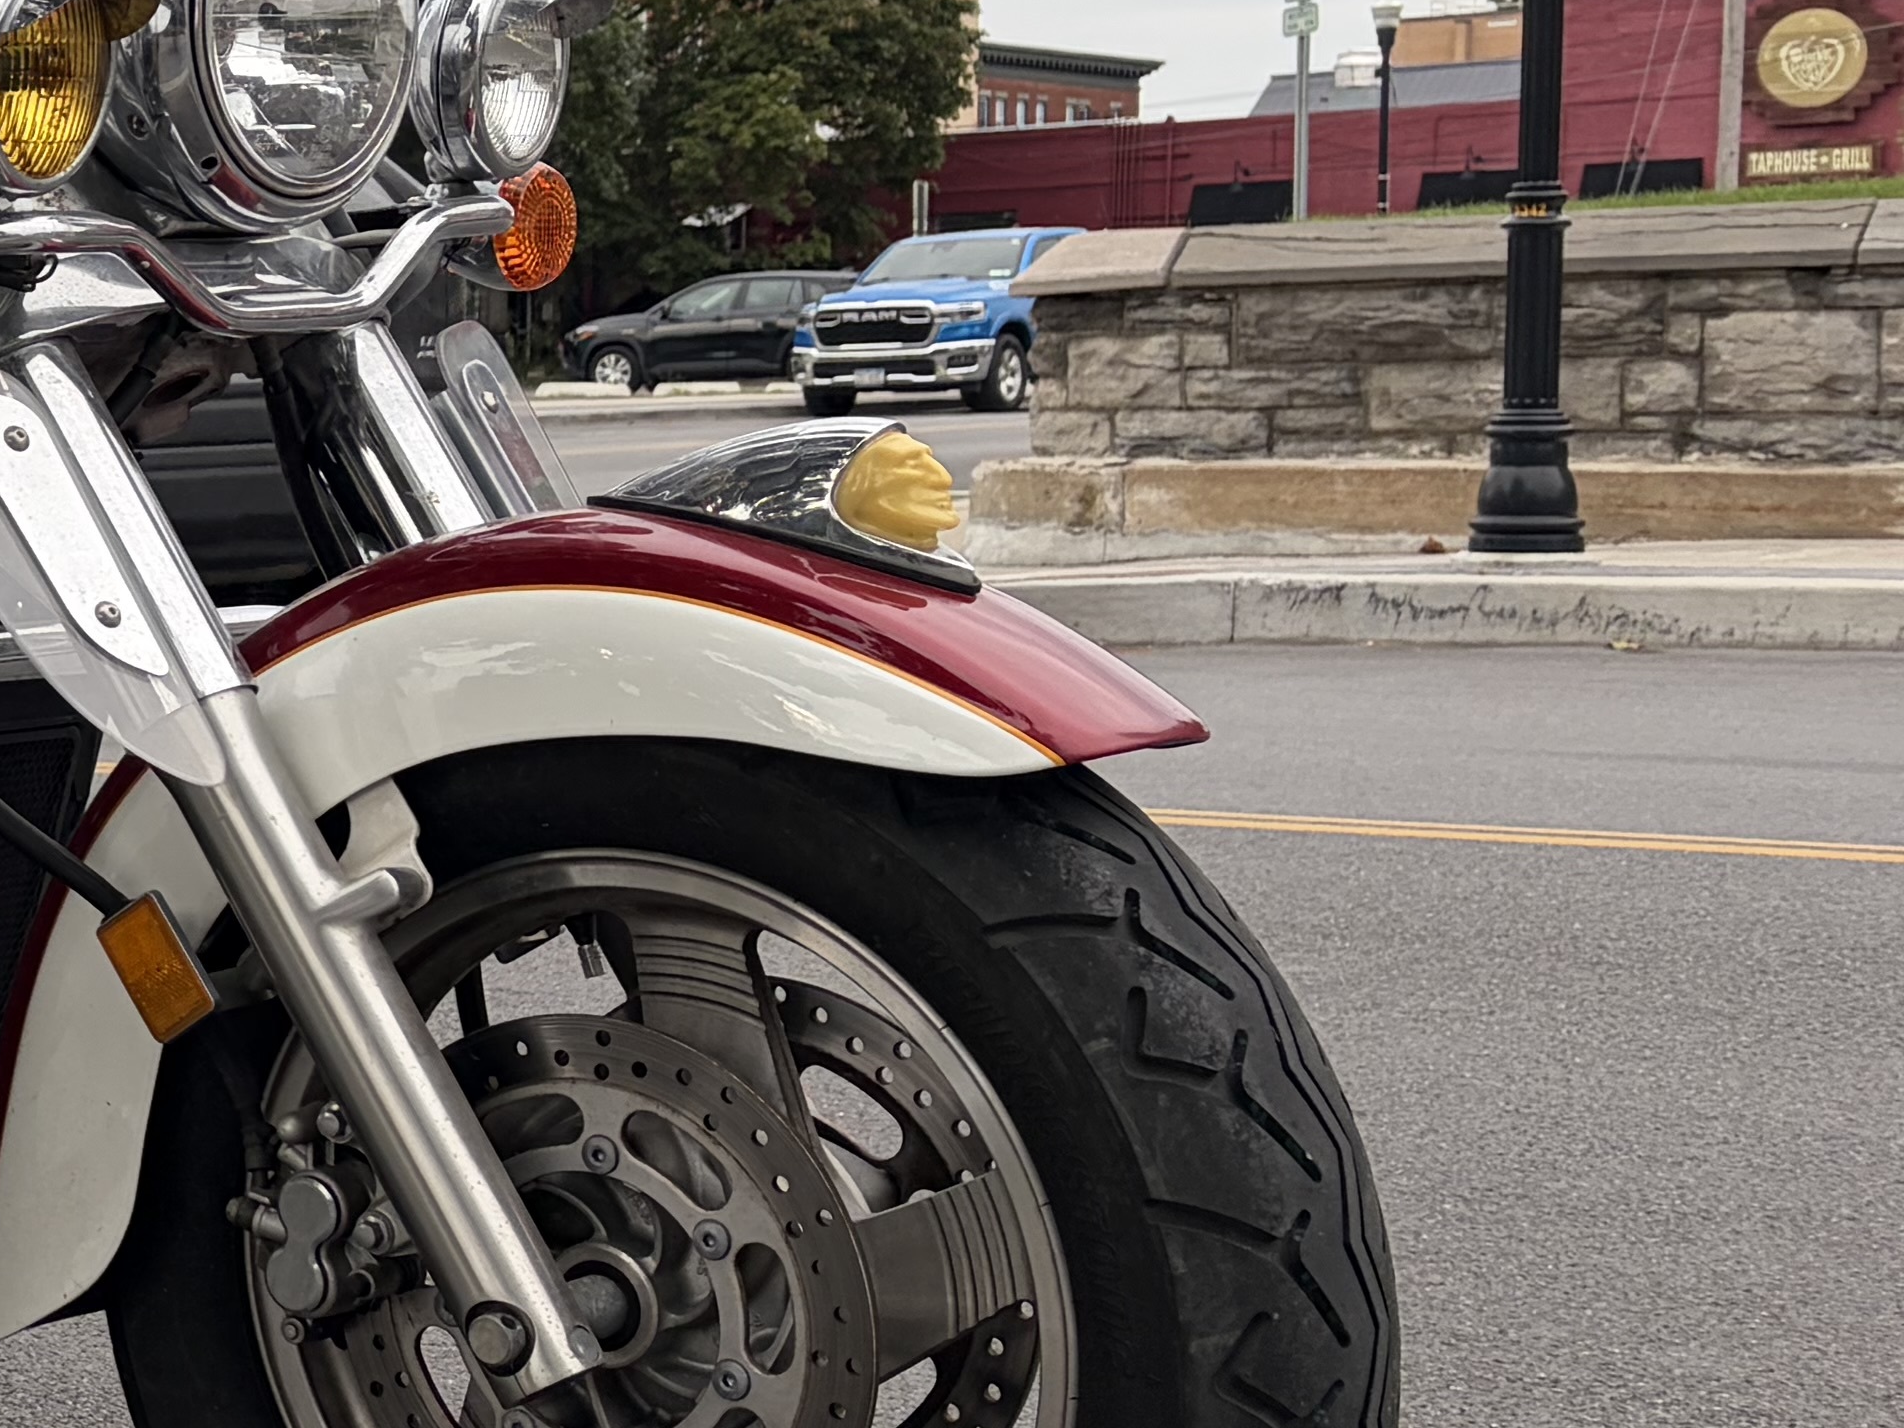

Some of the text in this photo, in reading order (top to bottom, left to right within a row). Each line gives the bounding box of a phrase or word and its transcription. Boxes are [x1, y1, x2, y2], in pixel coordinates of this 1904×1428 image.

[1749, 145, 1871, 173] TAPHOUSE GRILL
[843, 310, 898, 323] RAM
